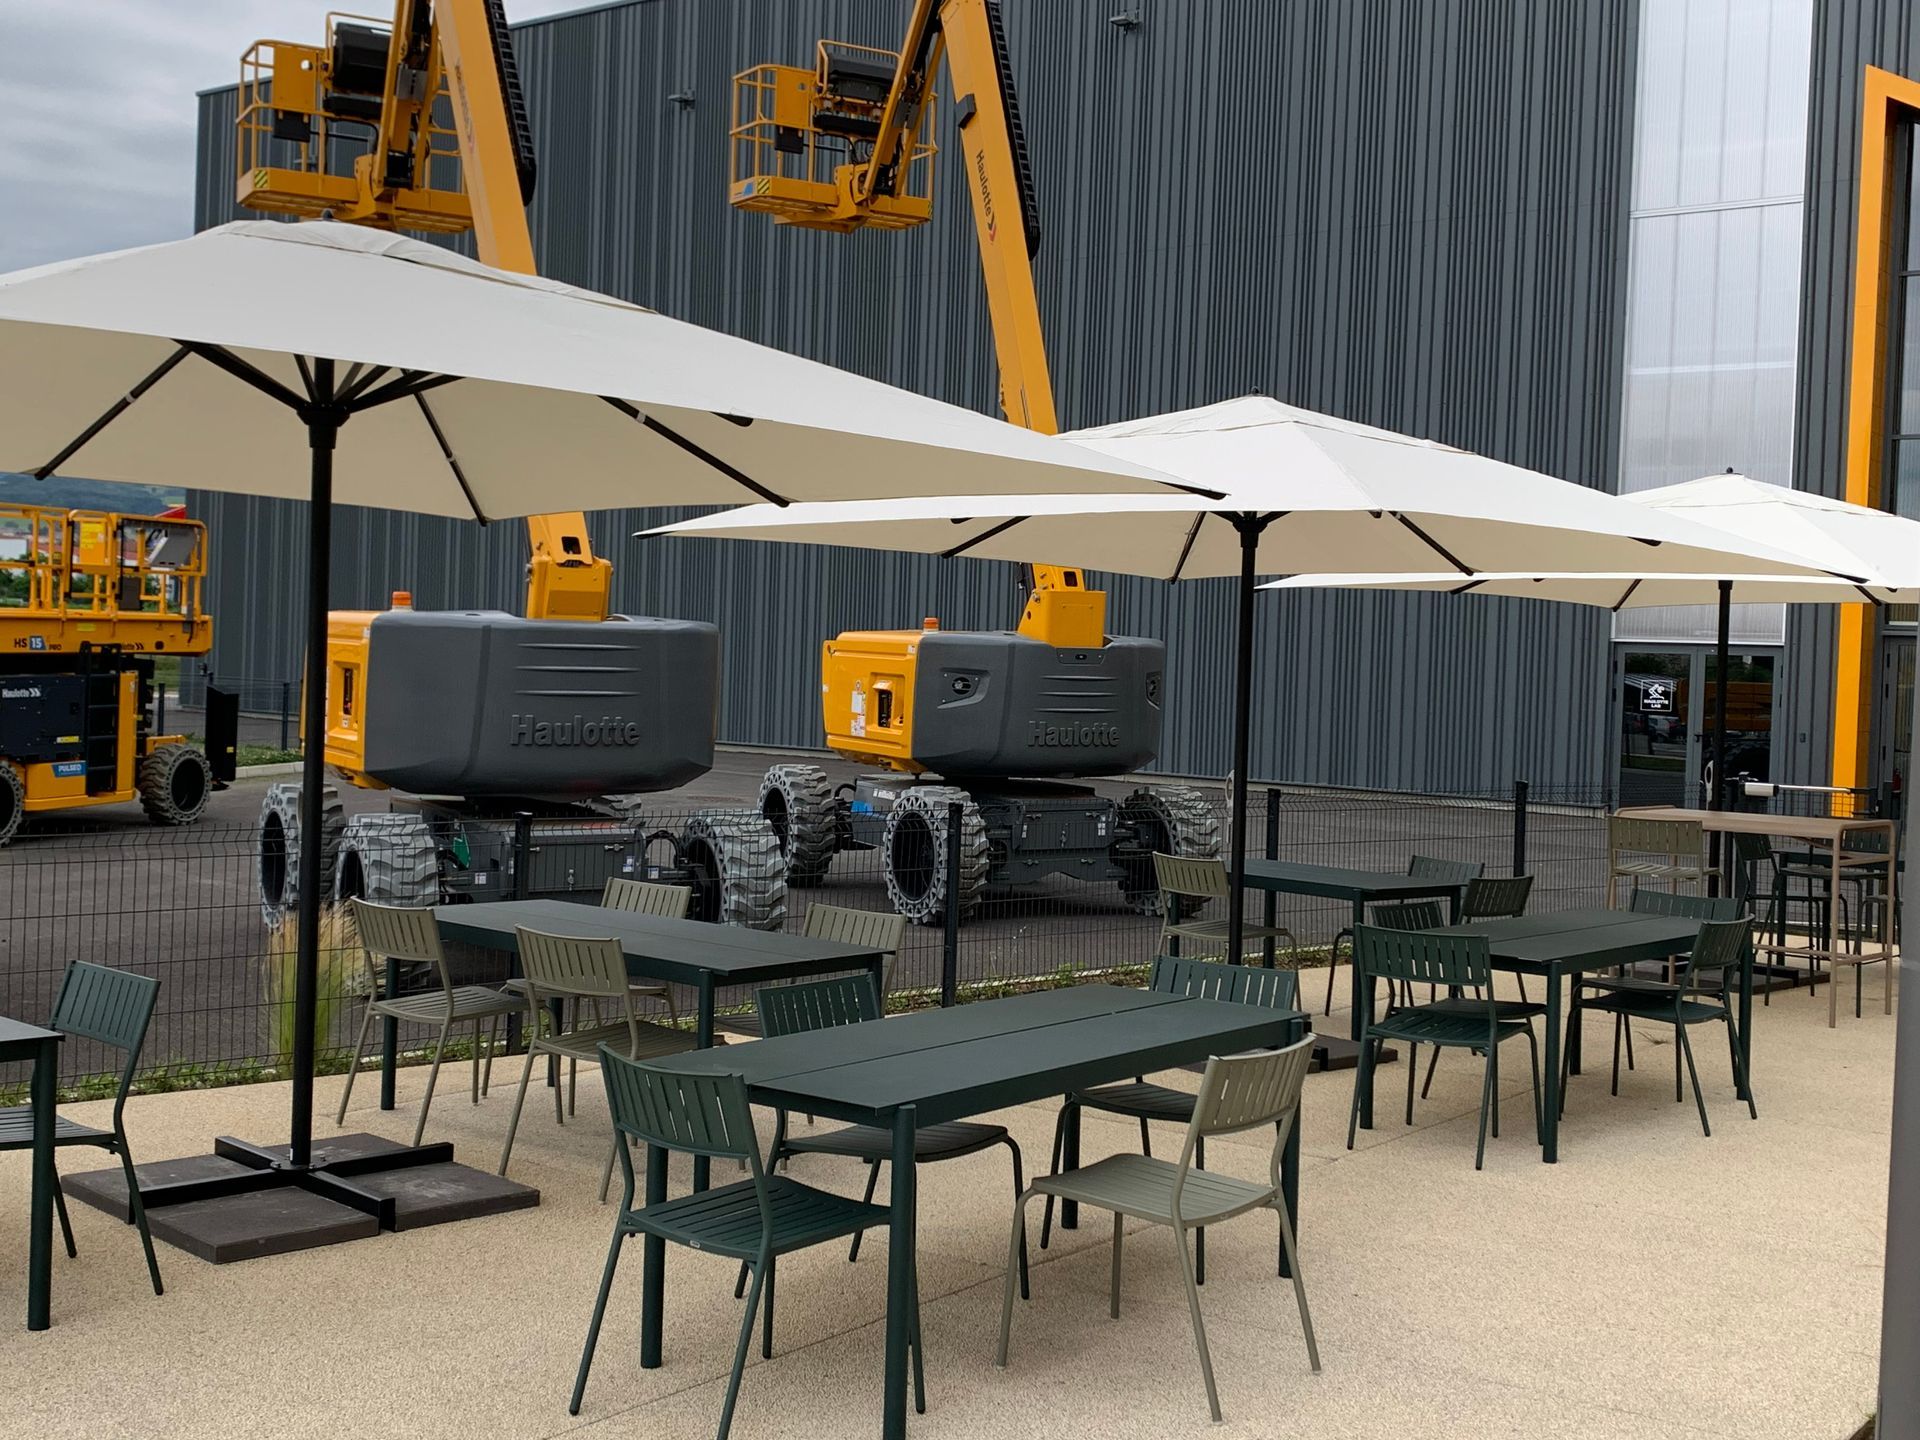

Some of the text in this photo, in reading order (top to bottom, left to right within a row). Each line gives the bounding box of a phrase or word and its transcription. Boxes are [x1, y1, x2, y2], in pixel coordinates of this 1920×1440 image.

[976, 149, 991, 216] Haulotte
[14, 638, 27, 648] HS
[31, 637, 42, 649] 15
[2, 688, 30, 698] Haulotte
[511, 714, 641, 746] Haulotte
[1027, 720, 1120, 747] Haulotte
